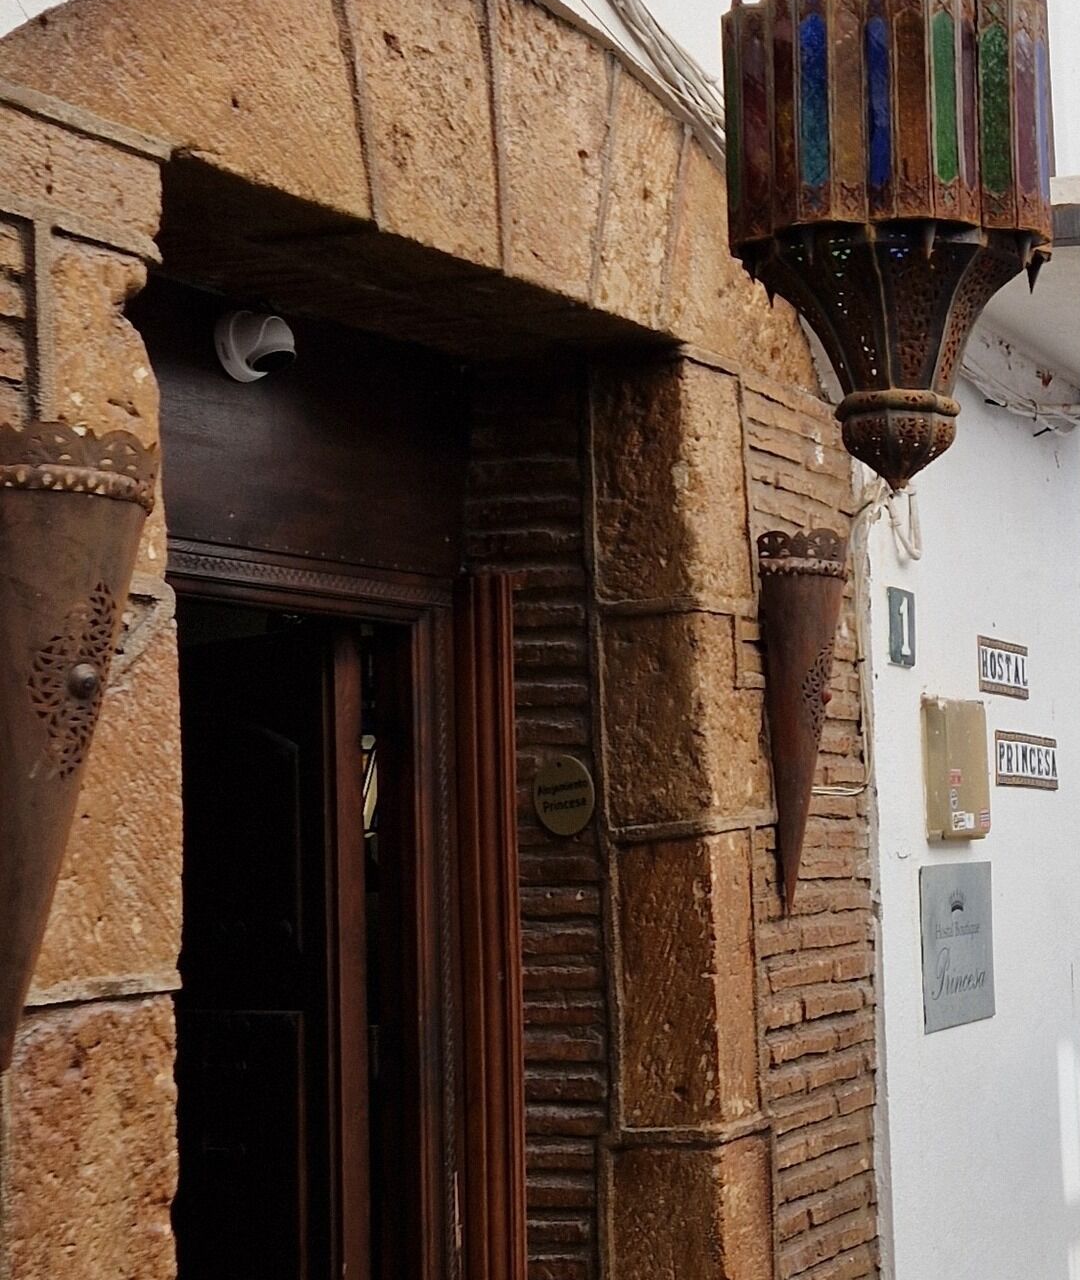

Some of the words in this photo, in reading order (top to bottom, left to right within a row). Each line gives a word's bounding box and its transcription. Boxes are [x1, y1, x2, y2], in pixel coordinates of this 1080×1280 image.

[899, 596, 911, 656] 1
[981, 649, 1028, 686] HOSTAL
[999, 743, 1058, 777] PRINCESA
[543, 798, 586, 813] Princesa
[931, 946, 986, 1001] Princesa
